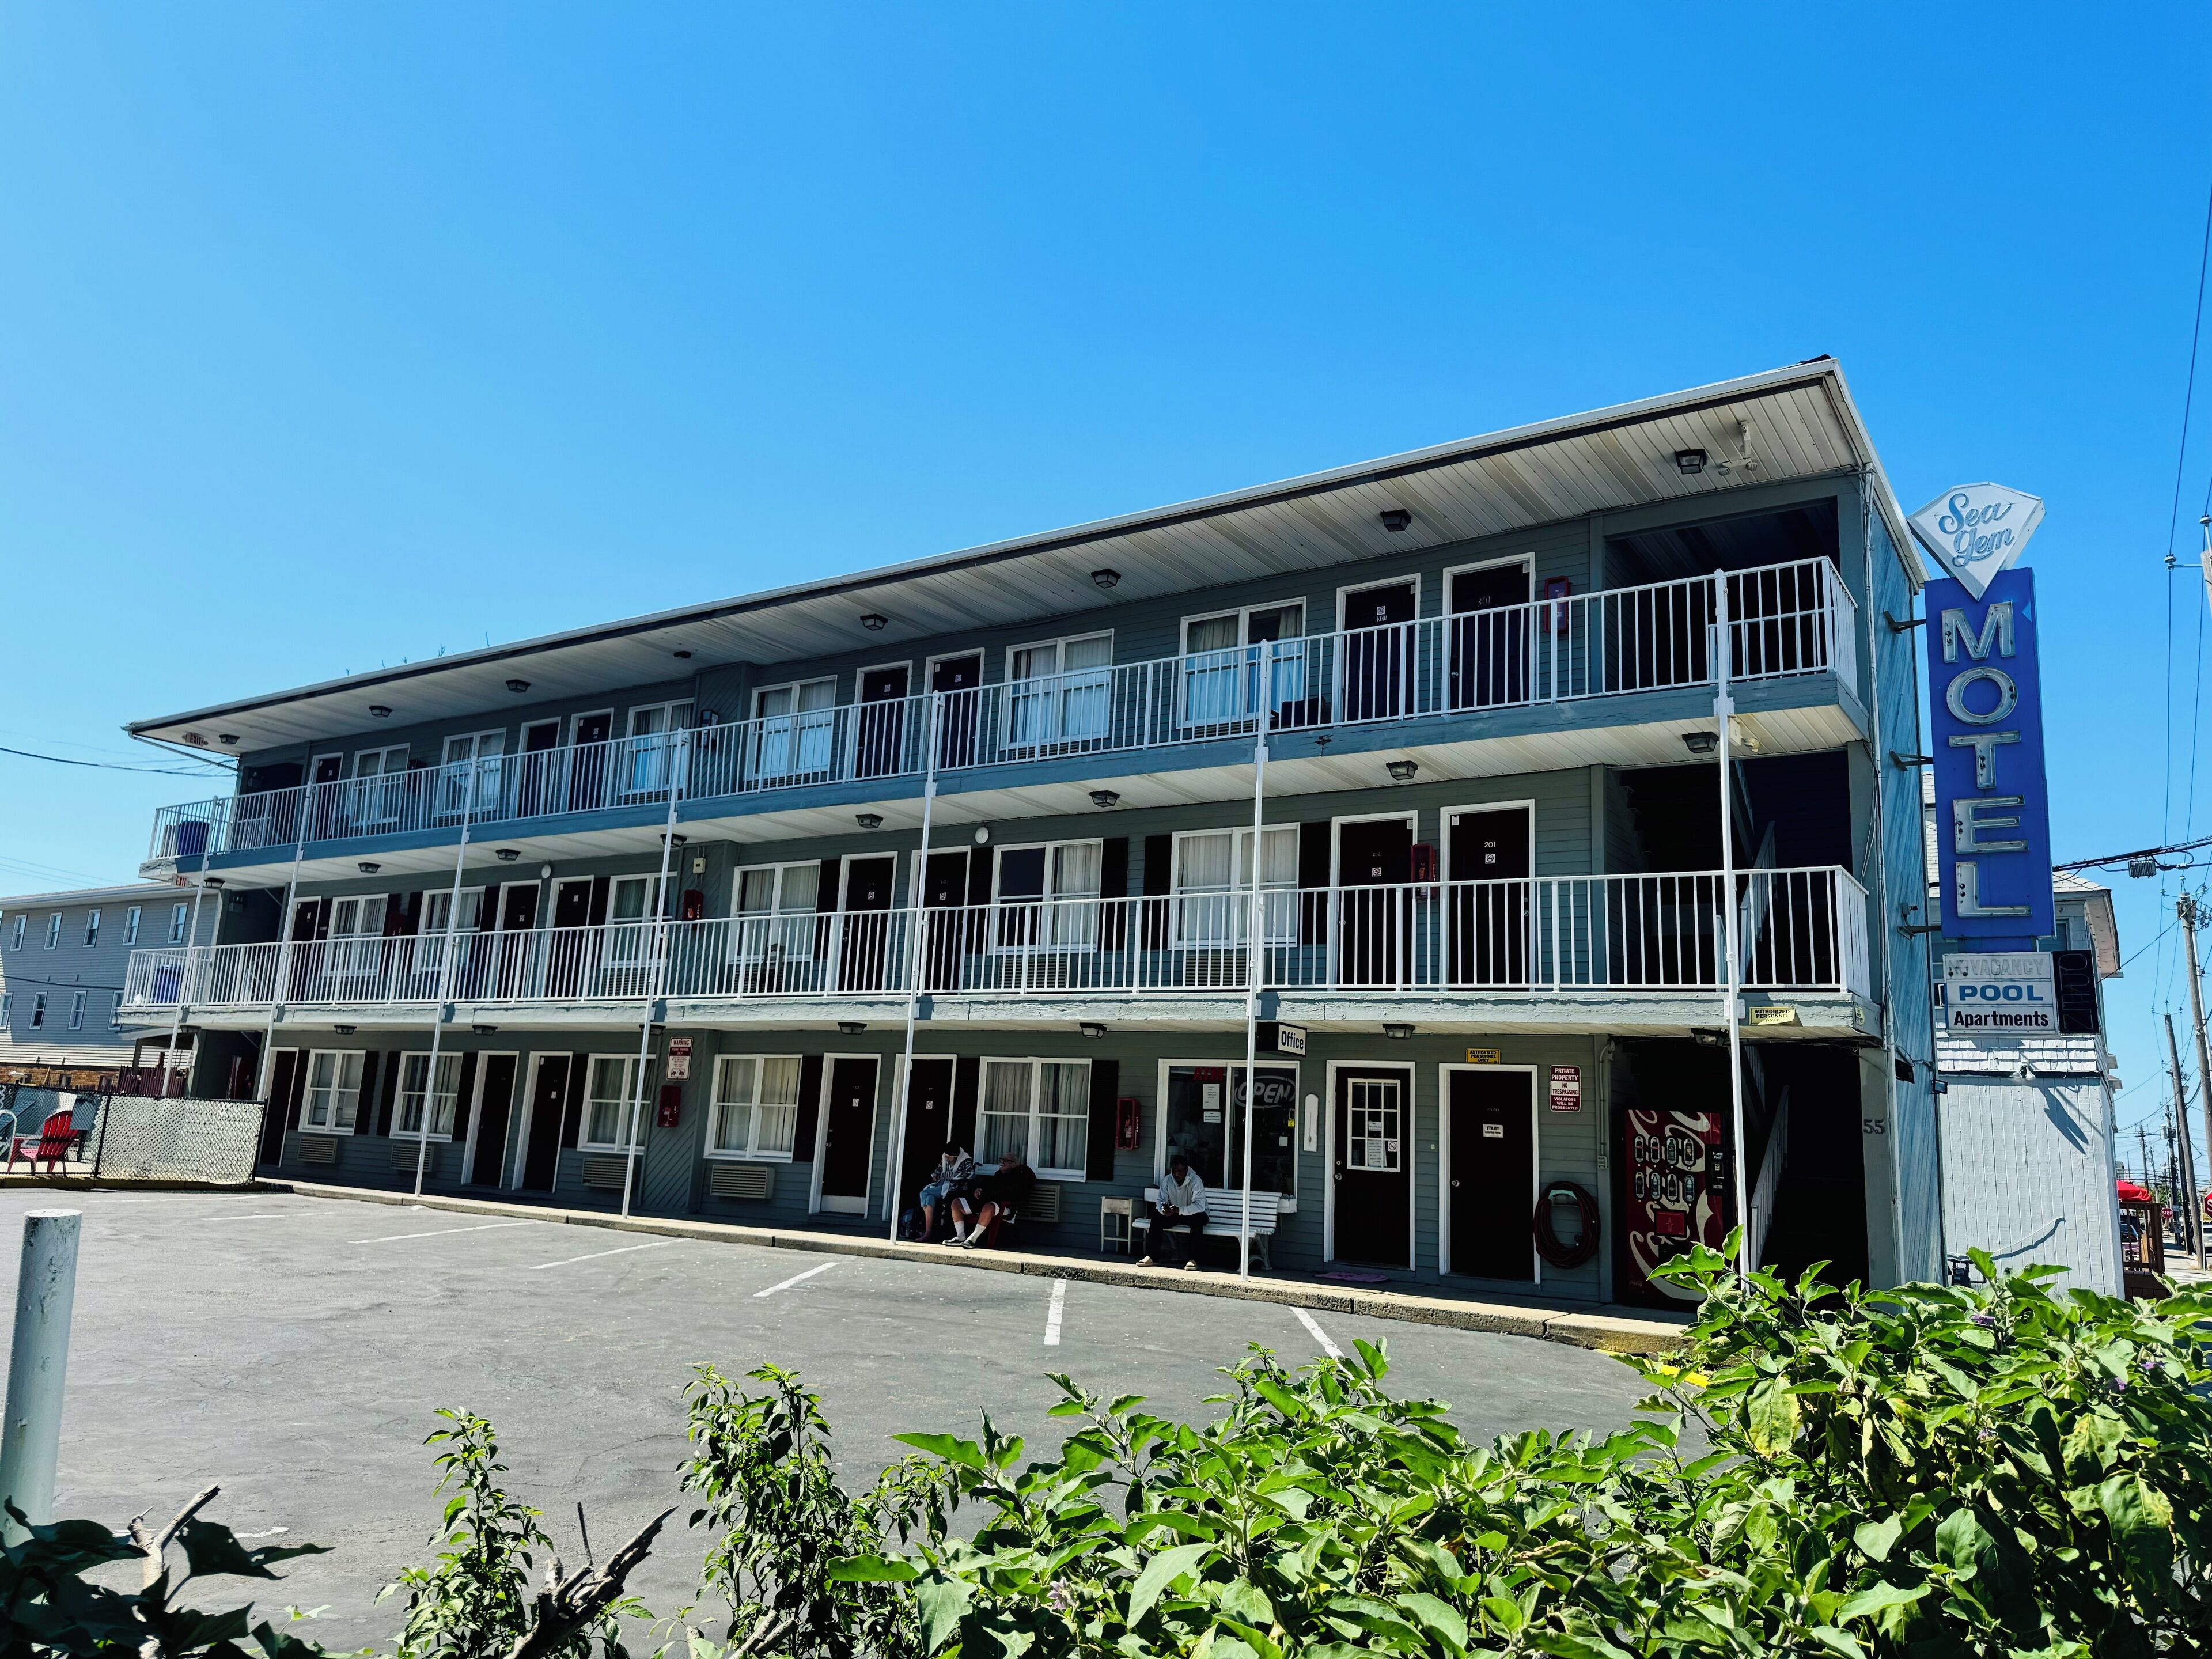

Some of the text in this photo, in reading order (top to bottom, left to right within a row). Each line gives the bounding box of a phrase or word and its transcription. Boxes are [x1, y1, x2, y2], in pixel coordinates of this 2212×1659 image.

[1938, 493, 2012, 535] Sea
[1941, 601, 2032, 918] MOTEL
[176, 876, 187, 887] EXIT
[1971, 959, 2044, 976] VACANCY
[1959, 984, 2044, 1001] POOL
[1953, 1010, 2048, 1028] Apartments
[1281, 1030, 1304, 1050] Office
[1863, 1119, 1885, 1134] 55
